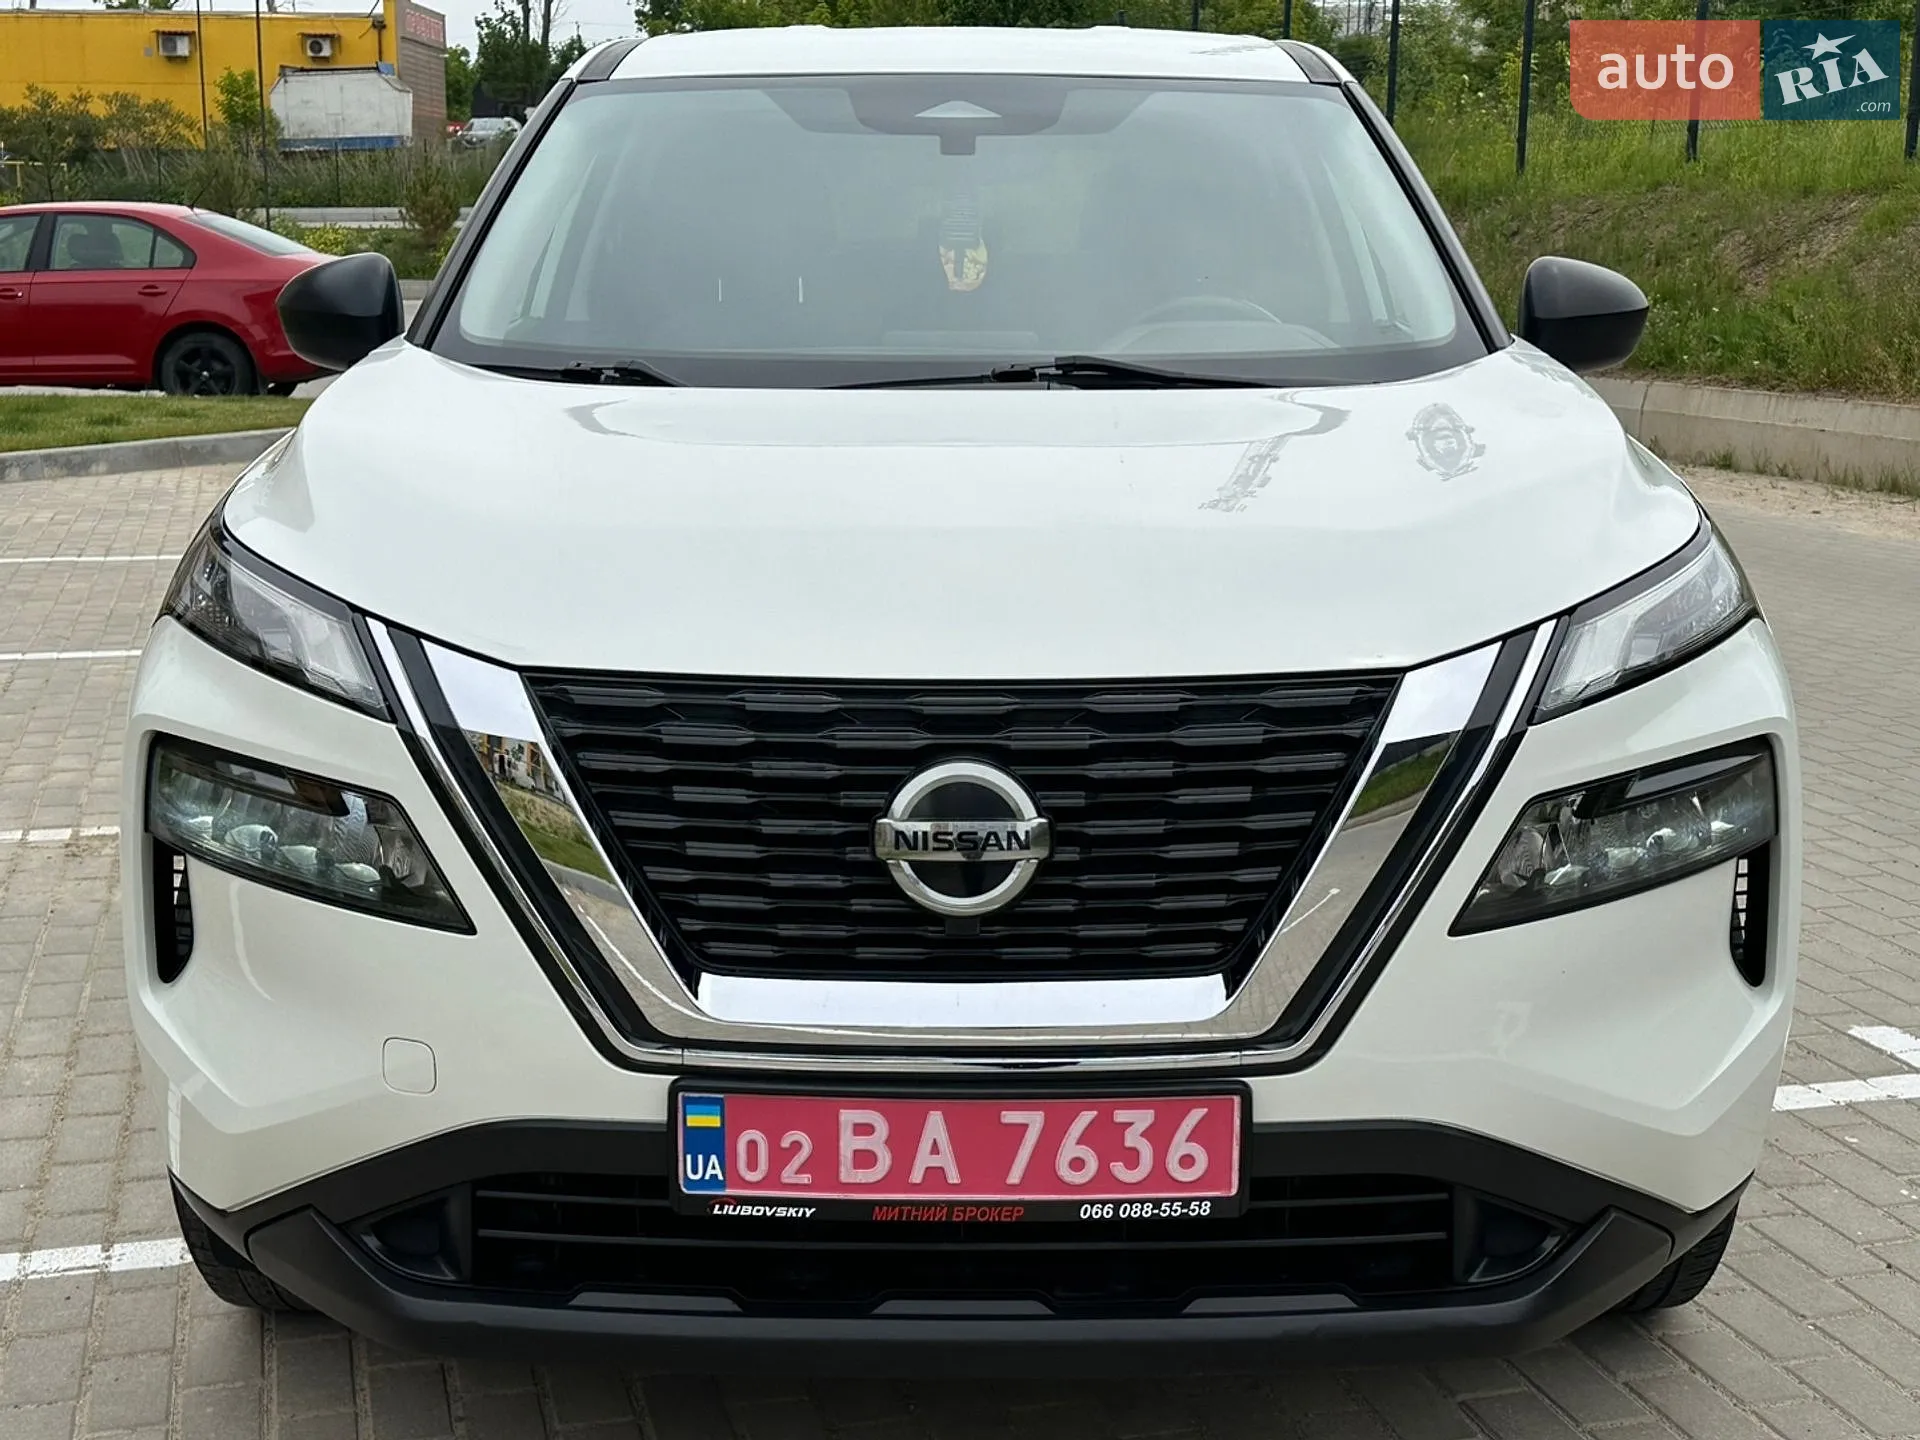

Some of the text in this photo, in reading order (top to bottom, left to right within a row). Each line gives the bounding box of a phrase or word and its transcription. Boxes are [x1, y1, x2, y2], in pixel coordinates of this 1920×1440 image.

[894, 830, 1031, 851] NISSAN
[736, 1108, 1209, 1185] 02 BA 7636
[686, 1154, 724, 1181] UA
[713, 1203, 816, 1218] LIUBOVSKIY
[872, 1203, 1025, 1221] МИТНИЙ БРОКЕР
[1080, 1201, 1212, 1219] 066 088-55-58
